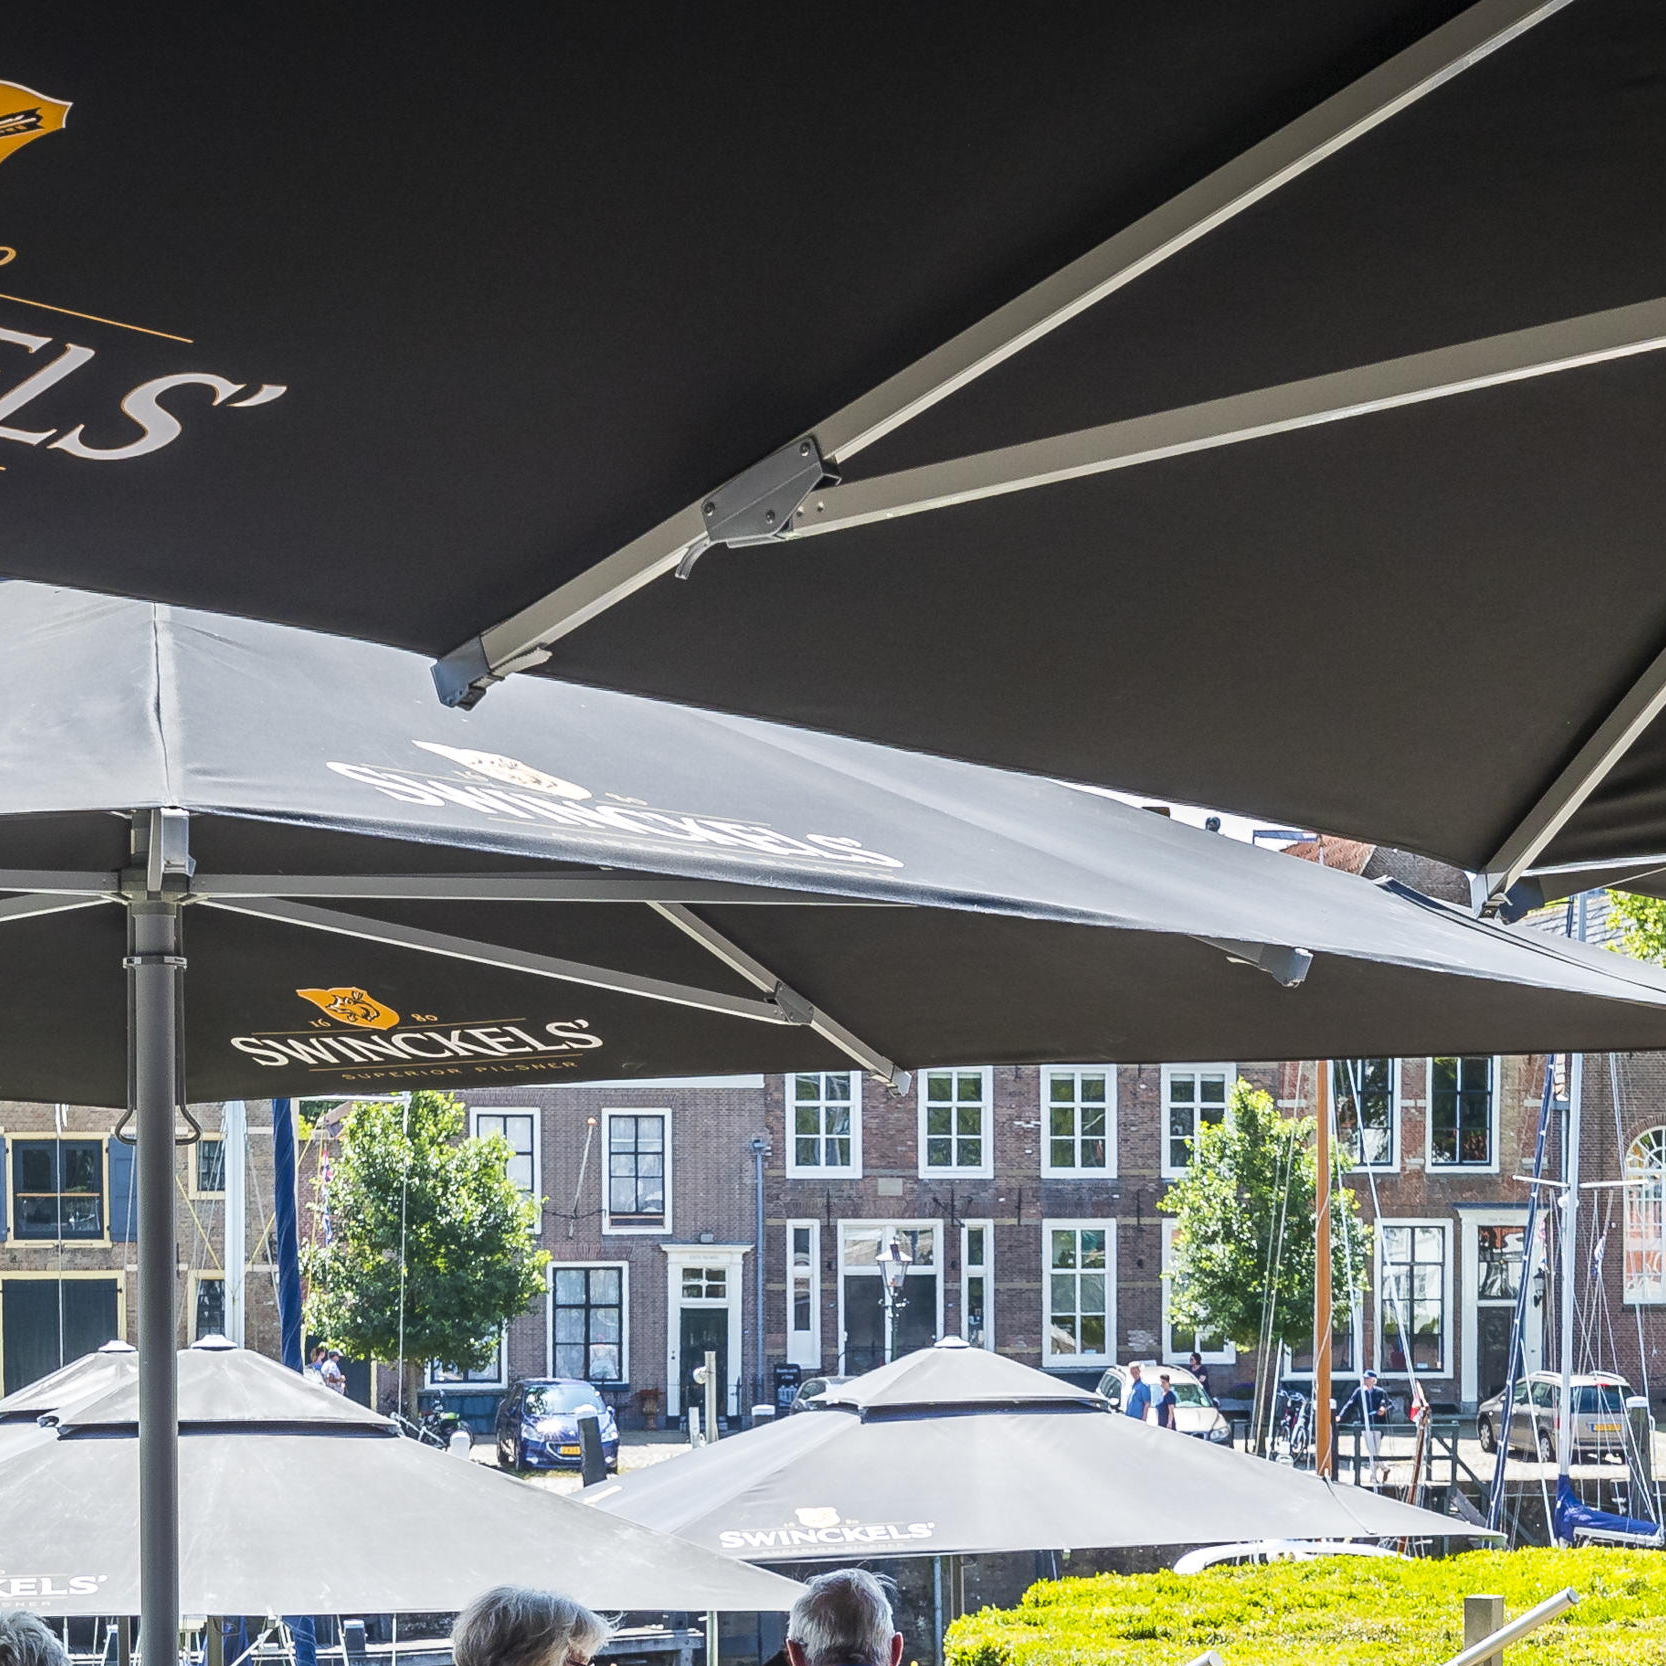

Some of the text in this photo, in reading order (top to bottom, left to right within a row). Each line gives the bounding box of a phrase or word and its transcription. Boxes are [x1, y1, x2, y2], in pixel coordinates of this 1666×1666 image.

[308, 1012, 439, 1029] 16 80
[341, 1060, 579, 1081] SUPERIOR PILSNER
